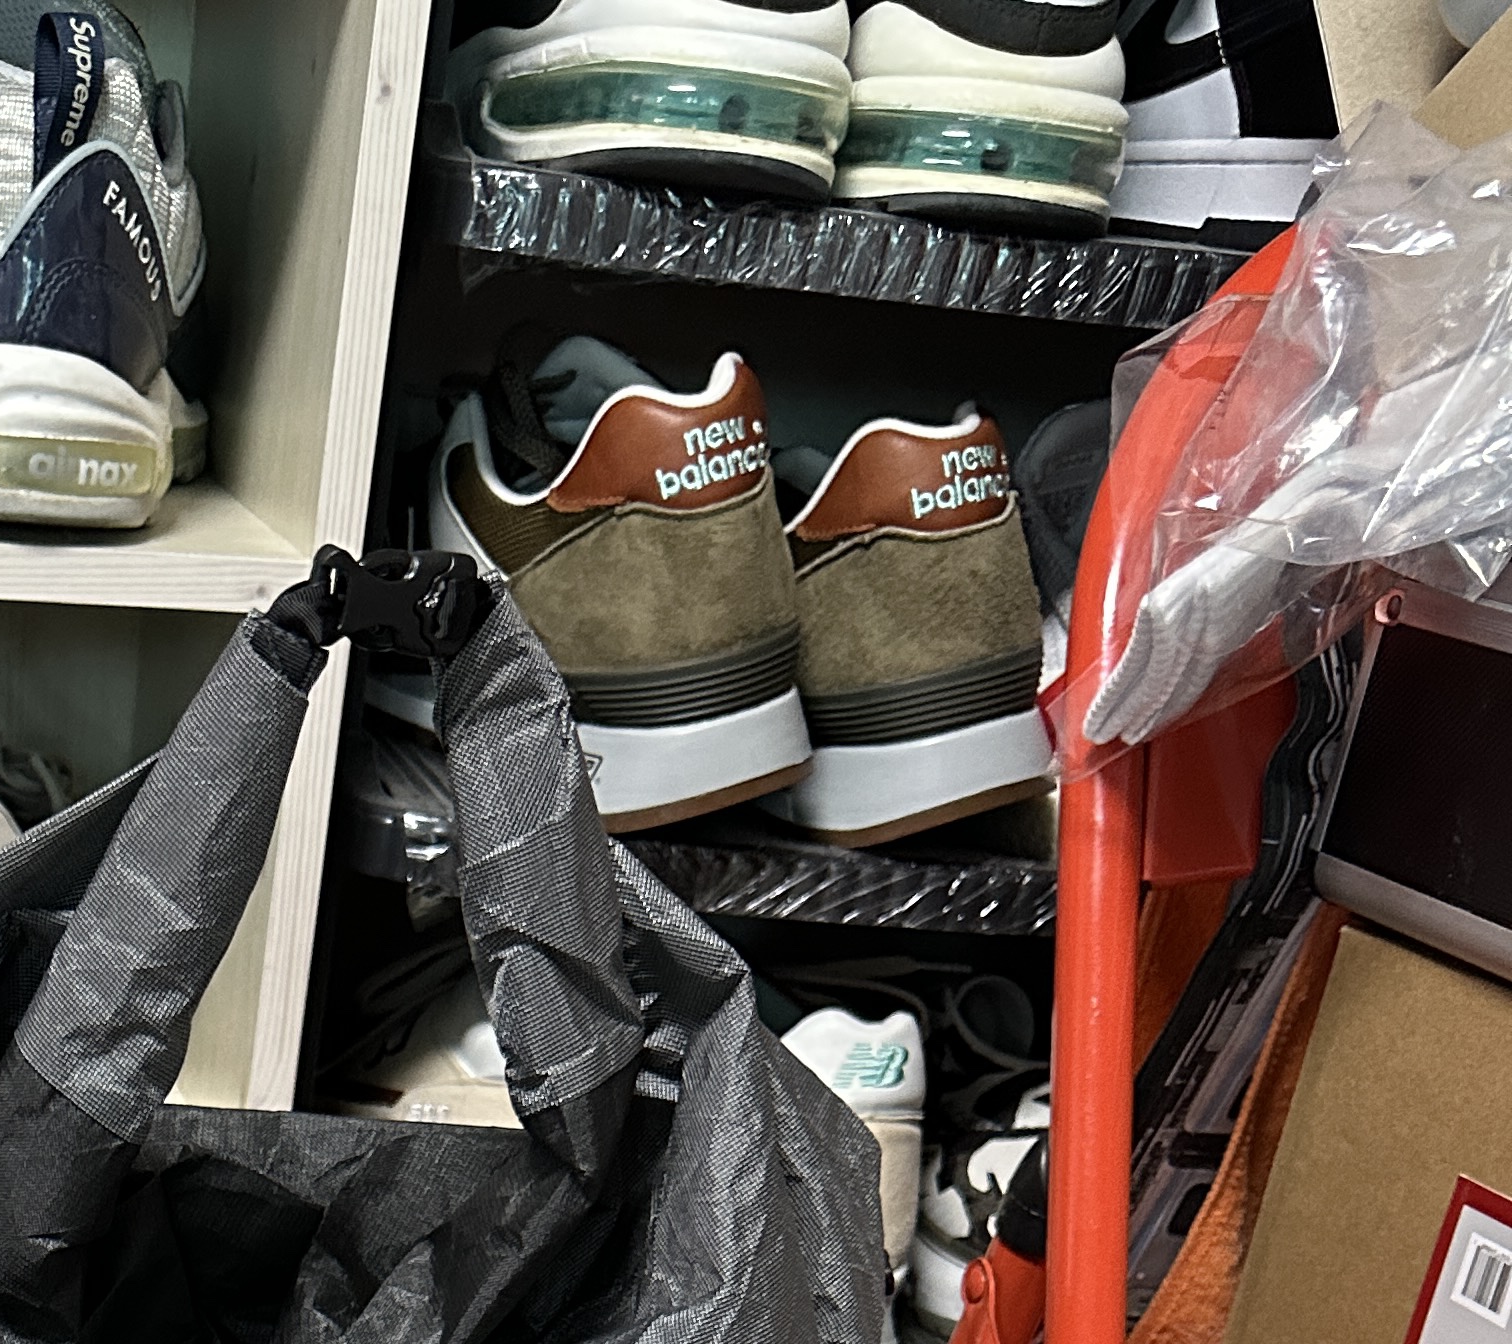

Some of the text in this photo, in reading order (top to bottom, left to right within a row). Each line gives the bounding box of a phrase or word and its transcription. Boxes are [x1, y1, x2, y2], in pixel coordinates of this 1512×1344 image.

[60, 17, 96, 147] Supreme
[102, 180, 162, 302] FAMOUS
[683, 416, 745, 456] new
